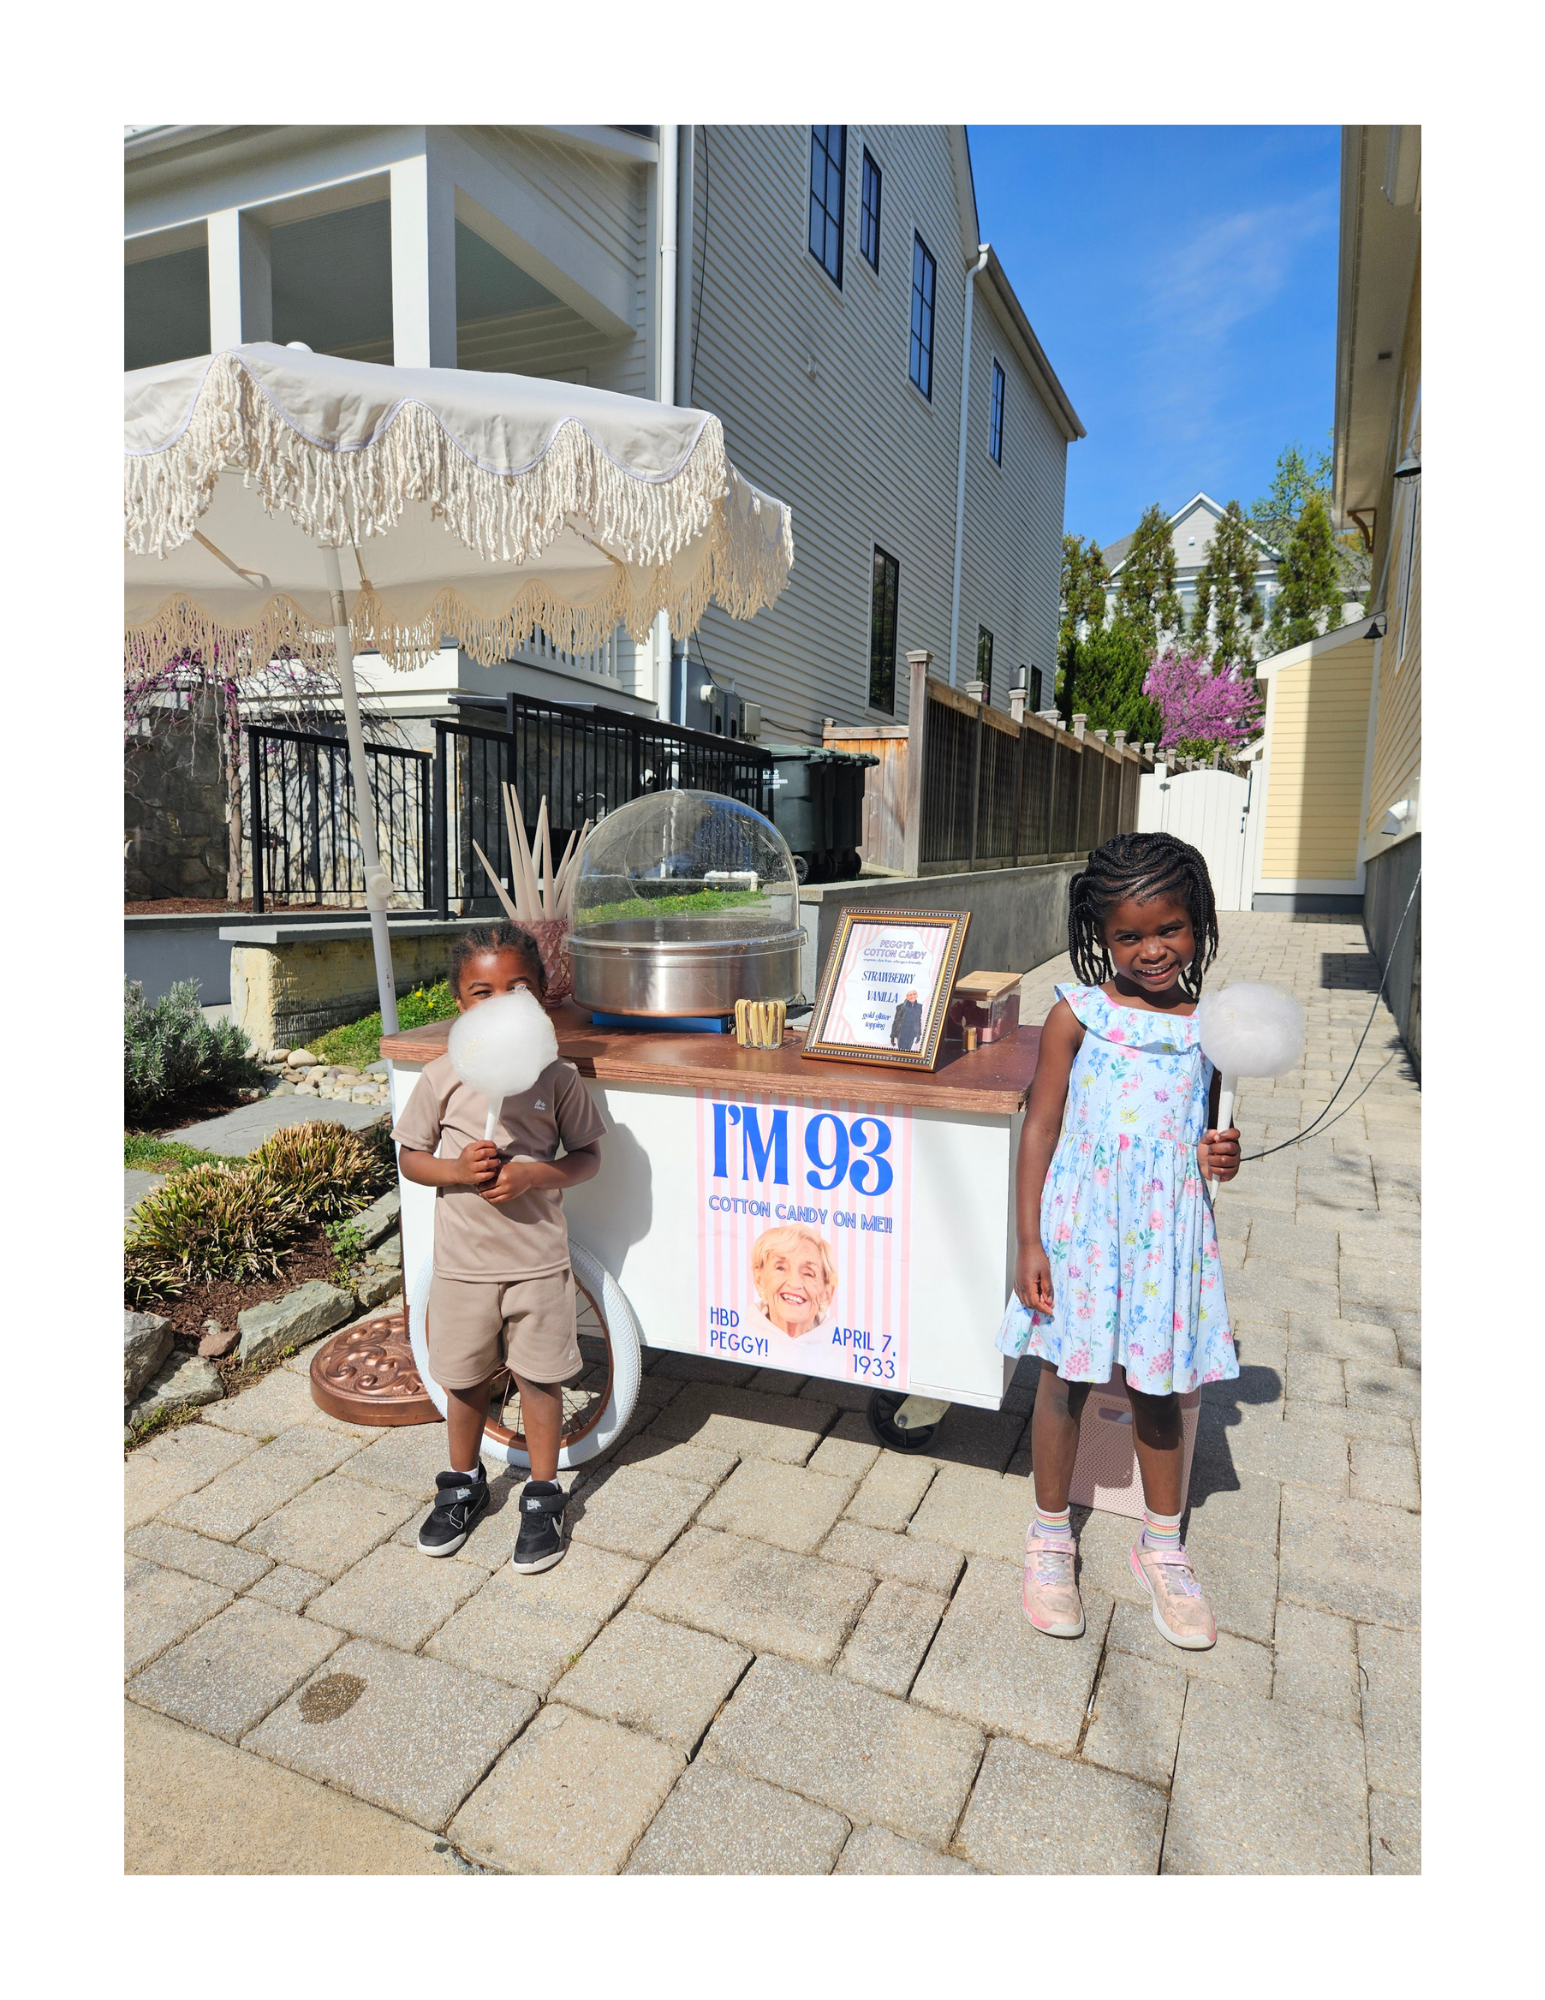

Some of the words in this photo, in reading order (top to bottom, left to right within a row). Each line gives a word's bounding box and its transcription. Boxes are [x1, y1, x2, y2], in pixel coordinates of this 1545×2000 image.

[880, 939, 914, 949] PEGGY'S
[863, 948, 898, 957] COTTON
[898, 950, 927, 959] CANDY
[861, 970, 915, 984] STRAWBERRY
[867, 990, 898, 1003] VANILLA
[862, 1011, 875, 1020] gold
[865, 1021, 885, 1030] topping
[711, 1102, 790, 1186] I'M
[804, 1112, 894, 1197] 93
[708, 1194, 771, 1218] COTTON
[775, 1203, 828, 1225] CANDY
[832, 1210, 857, 1229] ON
[860, 1213, 893, 1234] ME!!
[710, 1306, 740, 1328] HBD
[710, 1329, 769, 1357] PEGGY!
[831, 1326, 875, 1351] APRIL
[852, 1353, 896, 1380] 1933
